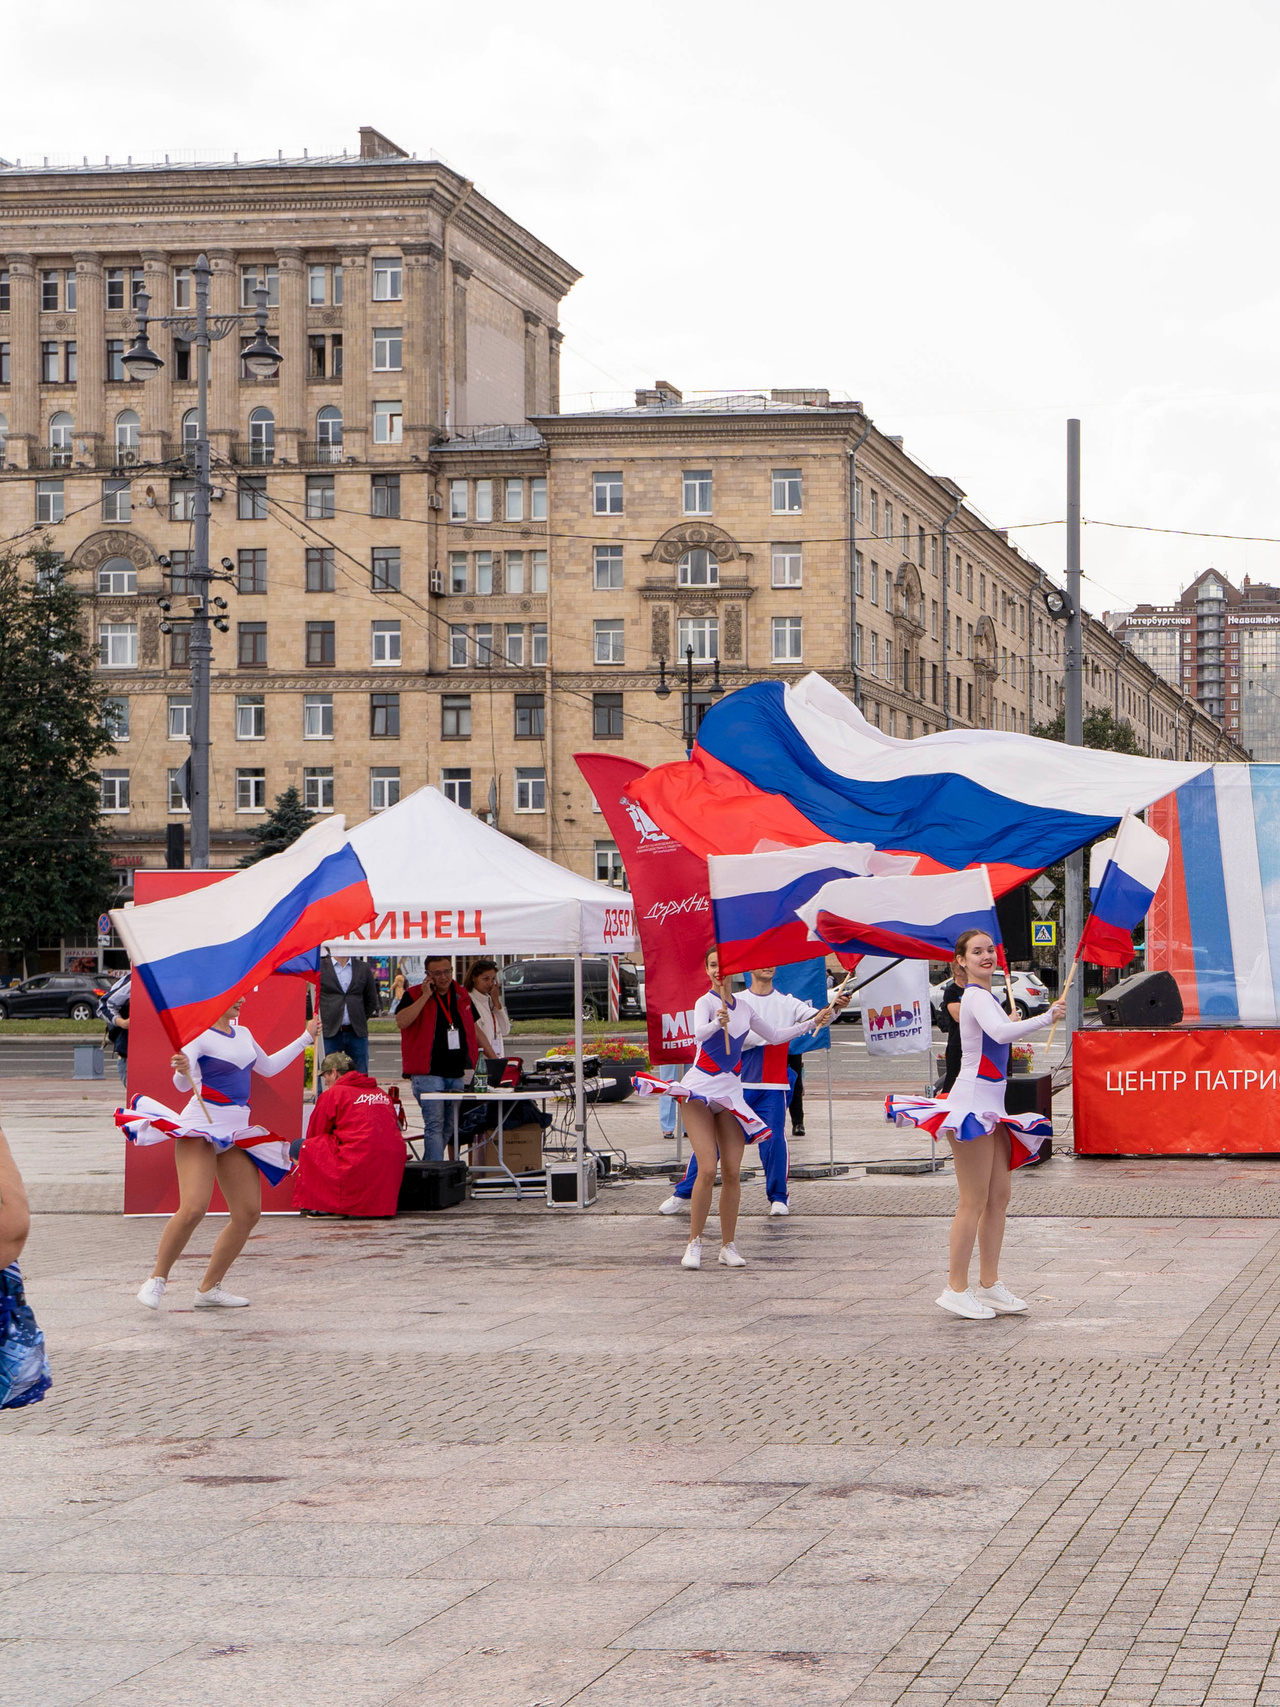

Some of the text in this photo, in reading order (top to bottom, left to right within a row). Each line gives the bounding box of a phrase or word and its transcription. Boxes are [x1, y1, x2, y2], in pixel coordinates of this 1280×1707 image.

[1126, 616, 1191, 626] Петербургская
[867, 1000, 922, 1032] МЫ
[870, 1026, 923, 1042] ПЕТЕРБУРГ
[1105, 1070, 1187, 1096] ЦЕНТР
